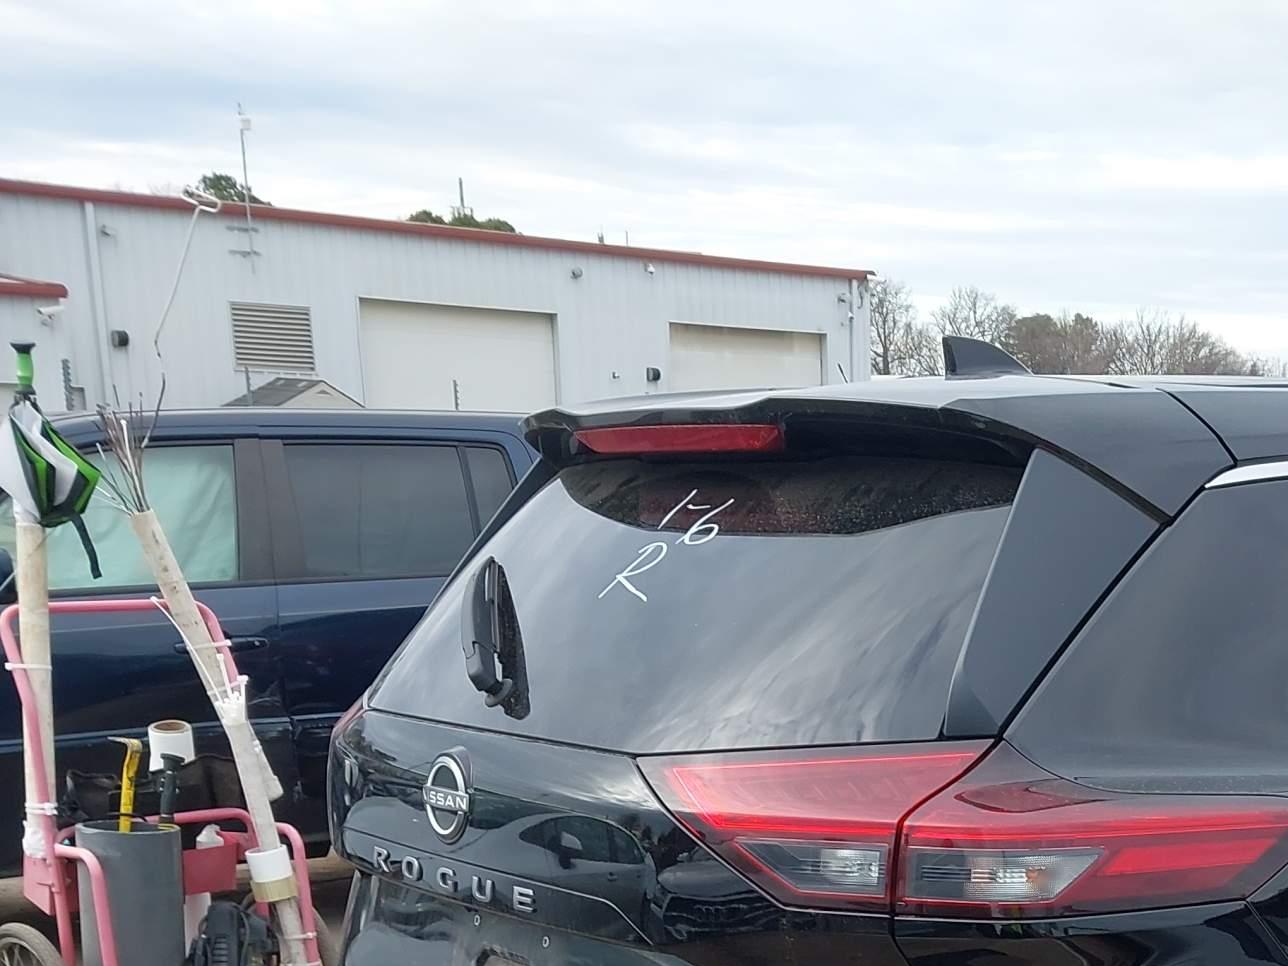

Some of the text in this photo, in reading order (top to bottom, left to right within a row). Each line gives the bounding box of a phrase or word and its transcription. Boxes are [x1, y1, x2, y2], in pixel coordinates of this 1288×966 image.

[657, 489, 735, 545] 1-6
[598, 541, 668, 602] R
[373, 845, 537, 913] ROGUE
